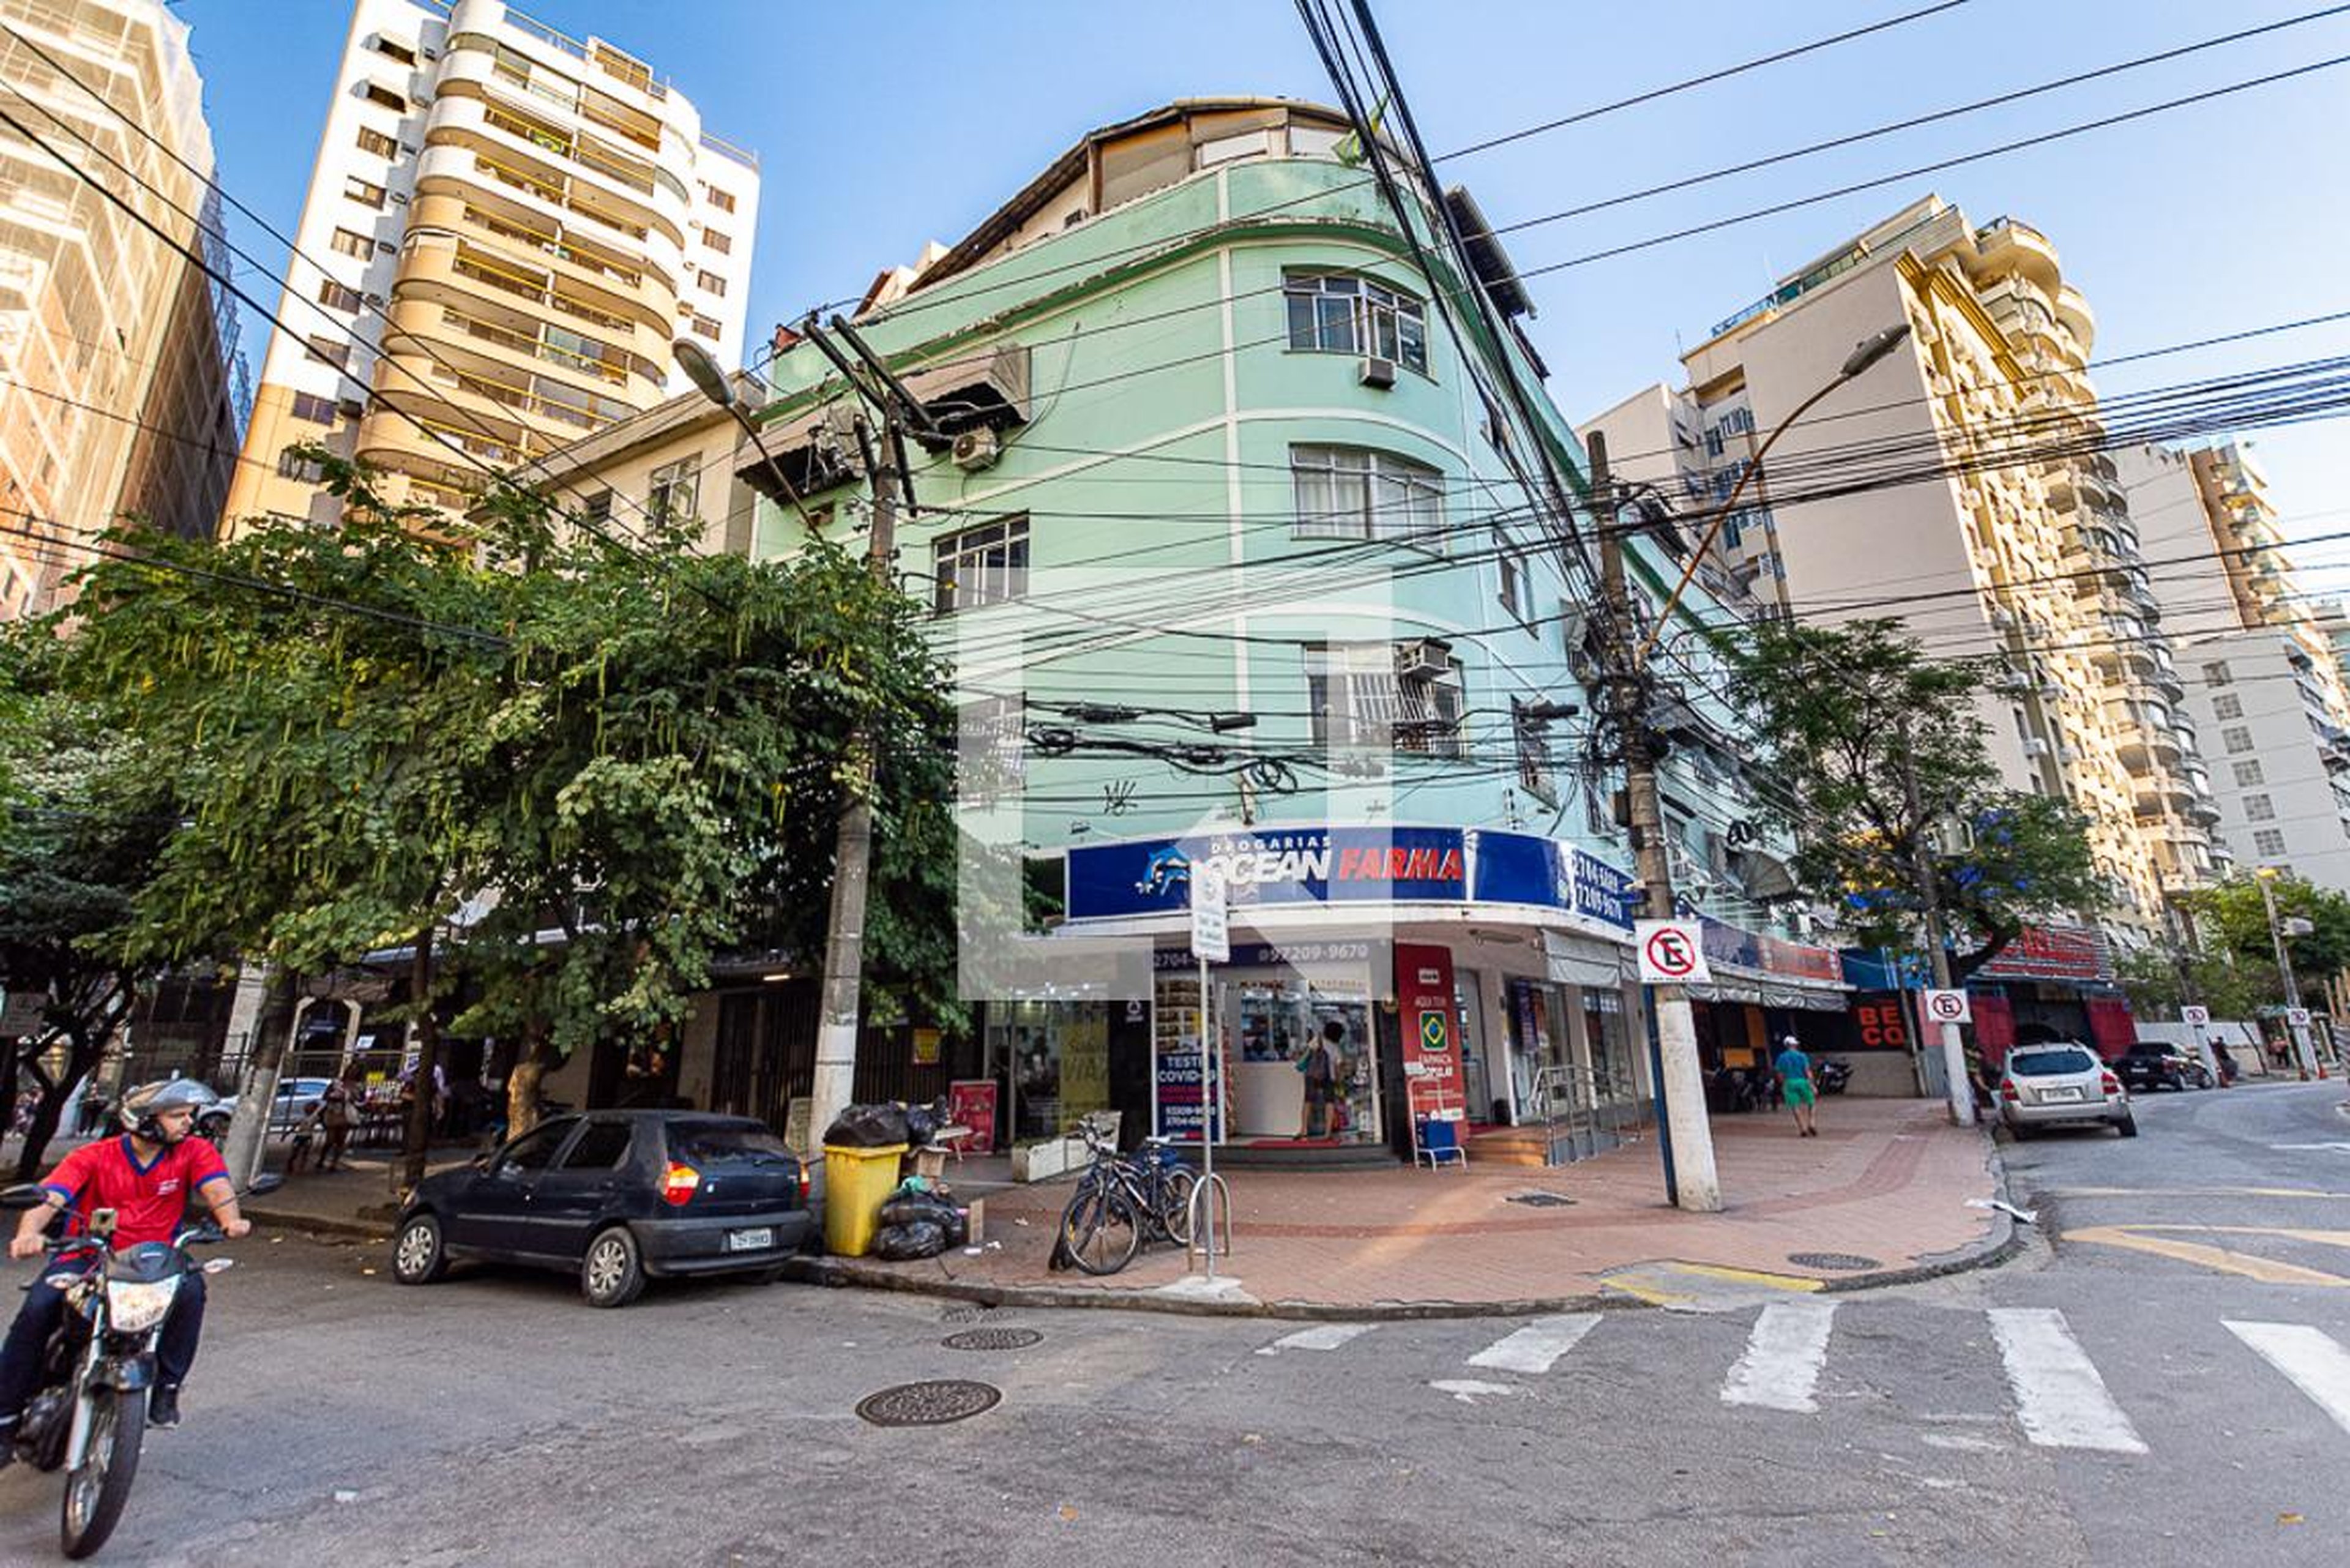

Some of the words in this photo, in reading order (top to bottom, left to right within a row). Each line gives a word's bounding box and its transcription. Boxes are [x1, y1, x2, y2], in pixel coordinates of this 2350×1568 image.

[1211, 835, 1332, 854] DROGARIAS
[1338, 848, 1463, 882] FARMA
[1859, 1007, 1901, 1025] BE
[1862, 1026, 1905, 1046] CO
